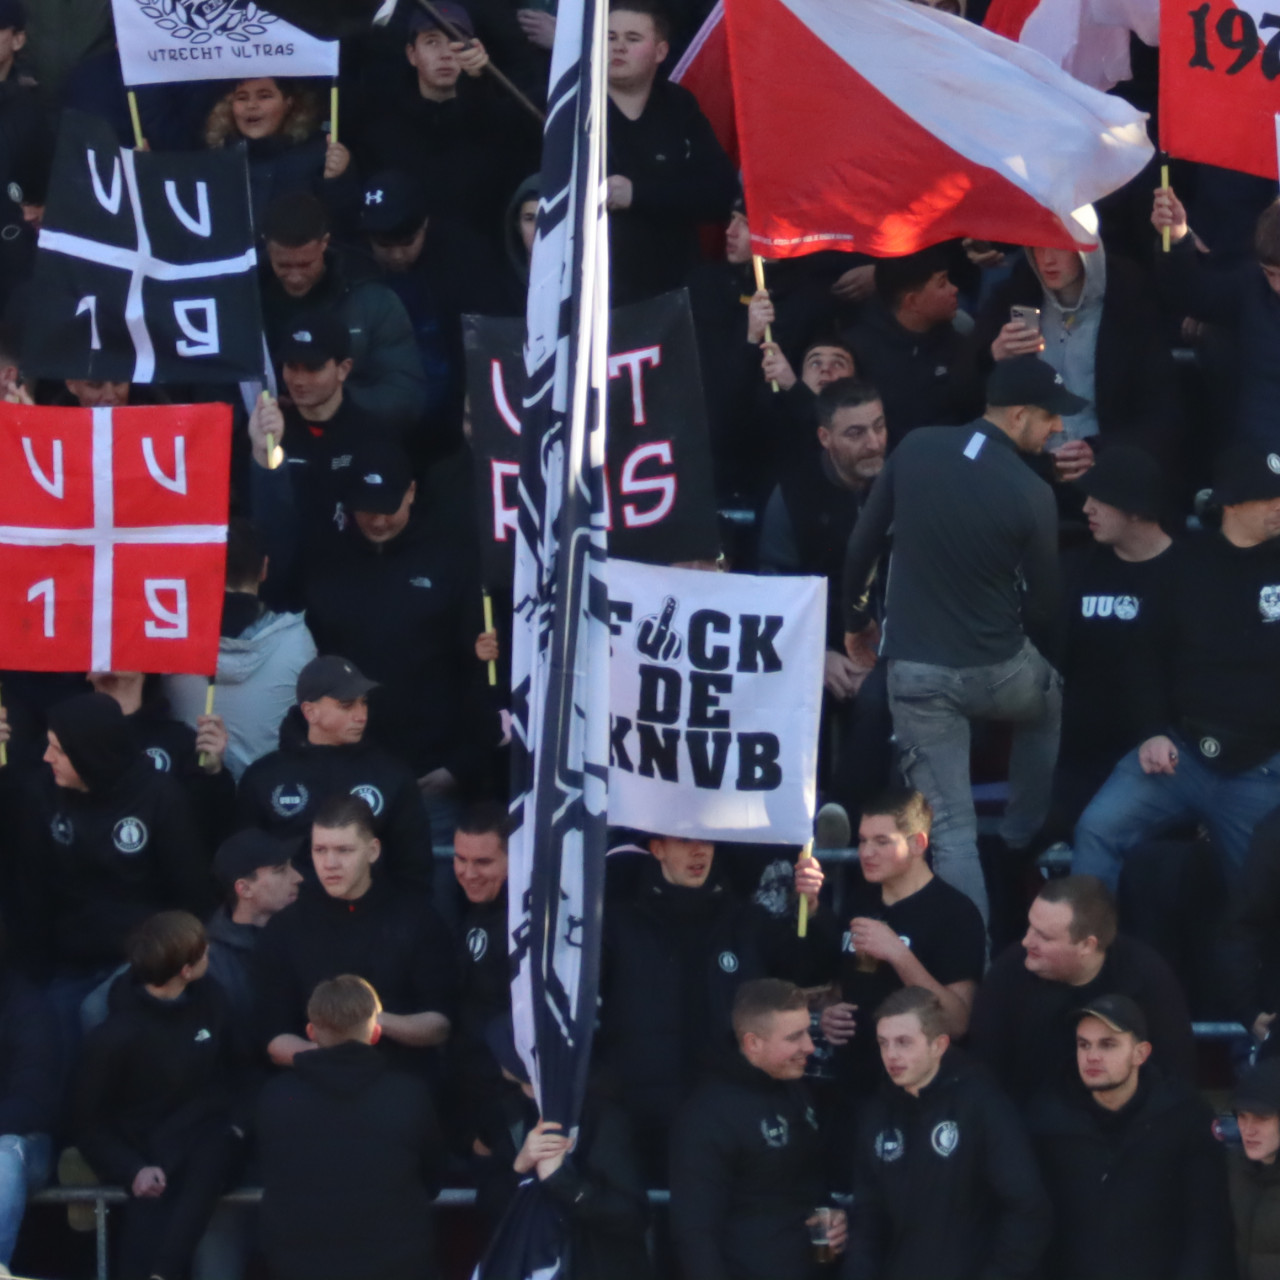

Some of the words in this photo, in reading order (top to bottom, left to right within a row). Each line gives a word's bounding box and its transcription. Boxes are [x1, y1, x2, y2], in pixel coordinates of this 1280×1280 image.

[148, 44, 223, 62] UTRECHT
[232, 42, 295, 60] ULTRAS
[638, 664, 733, 729] DE
[609, 716, 783, 792] KNVB
